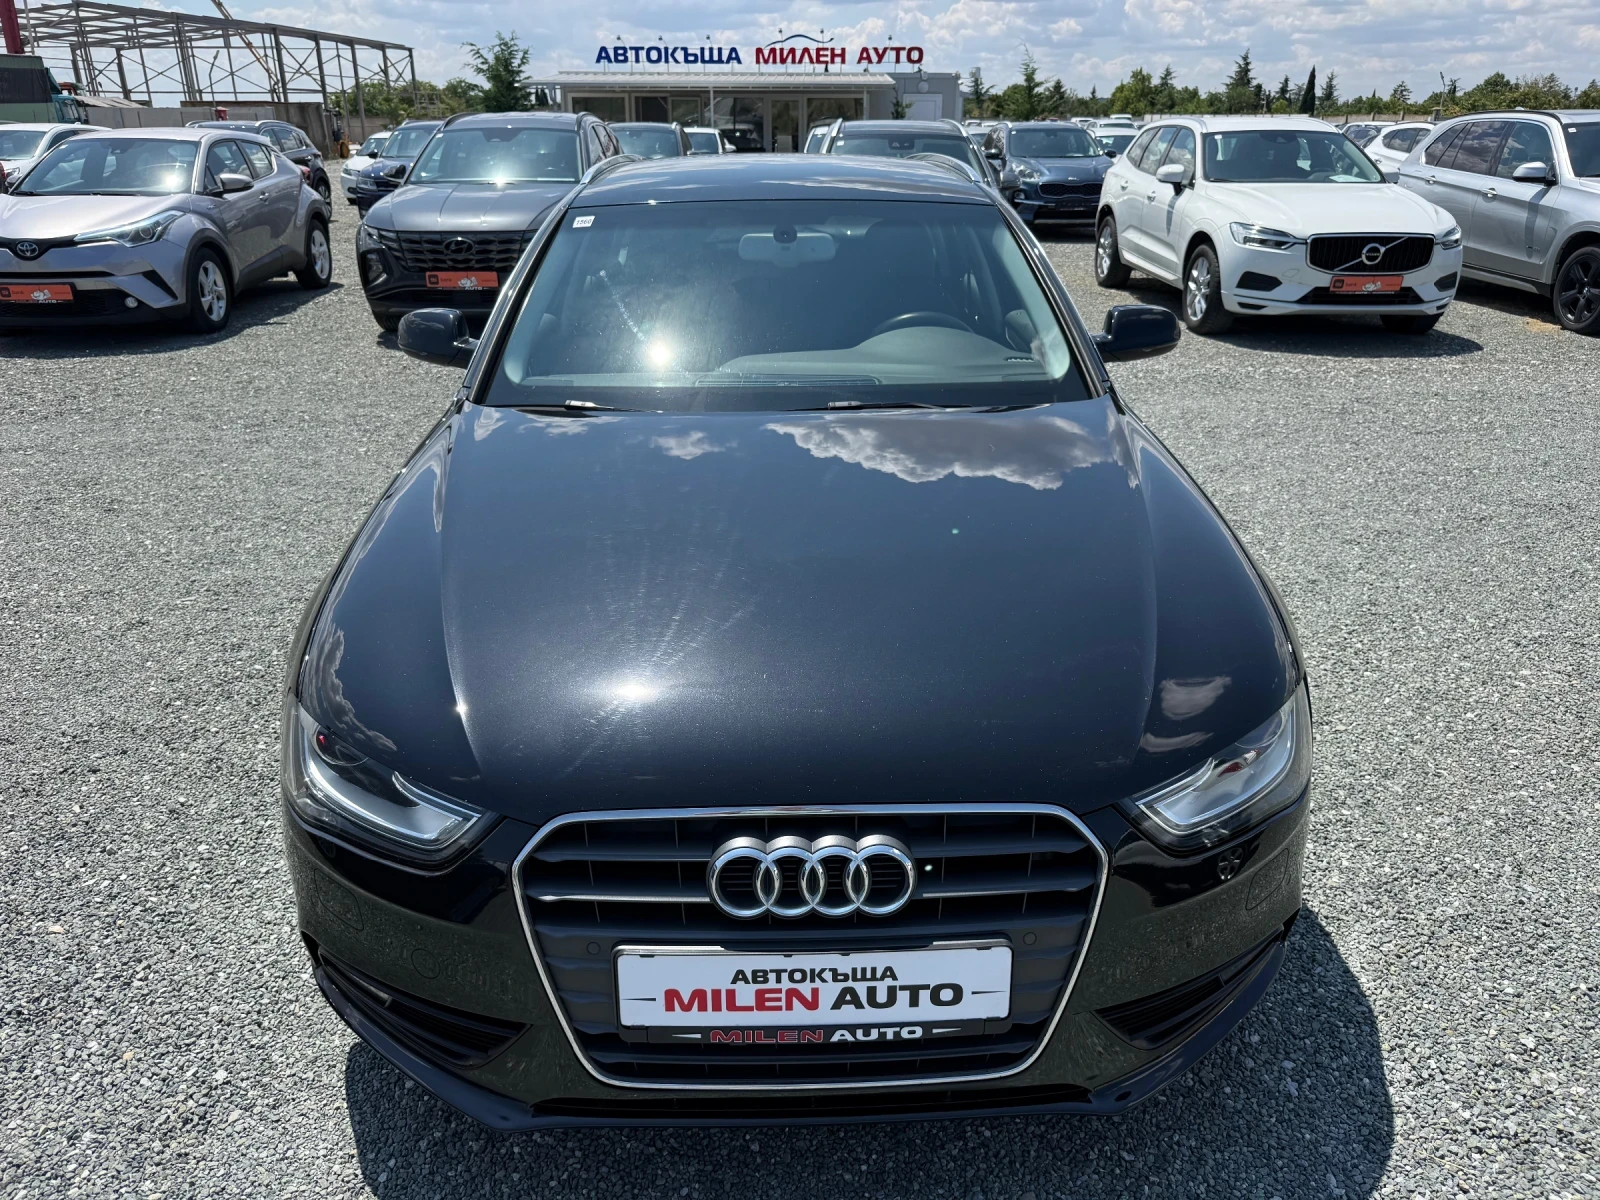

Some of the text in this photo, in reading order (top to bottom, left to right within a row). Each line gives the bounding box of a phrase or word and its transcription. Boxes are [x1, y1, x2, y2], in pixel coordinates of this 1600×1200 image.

[755, 47, 846, 65] МИЛЕН
[857, 46, 924, 65] АУТО
[663, 982, 965, 1013] MILEN AUTO
[709, 1025, 924, 1044] MILEN AUTO
